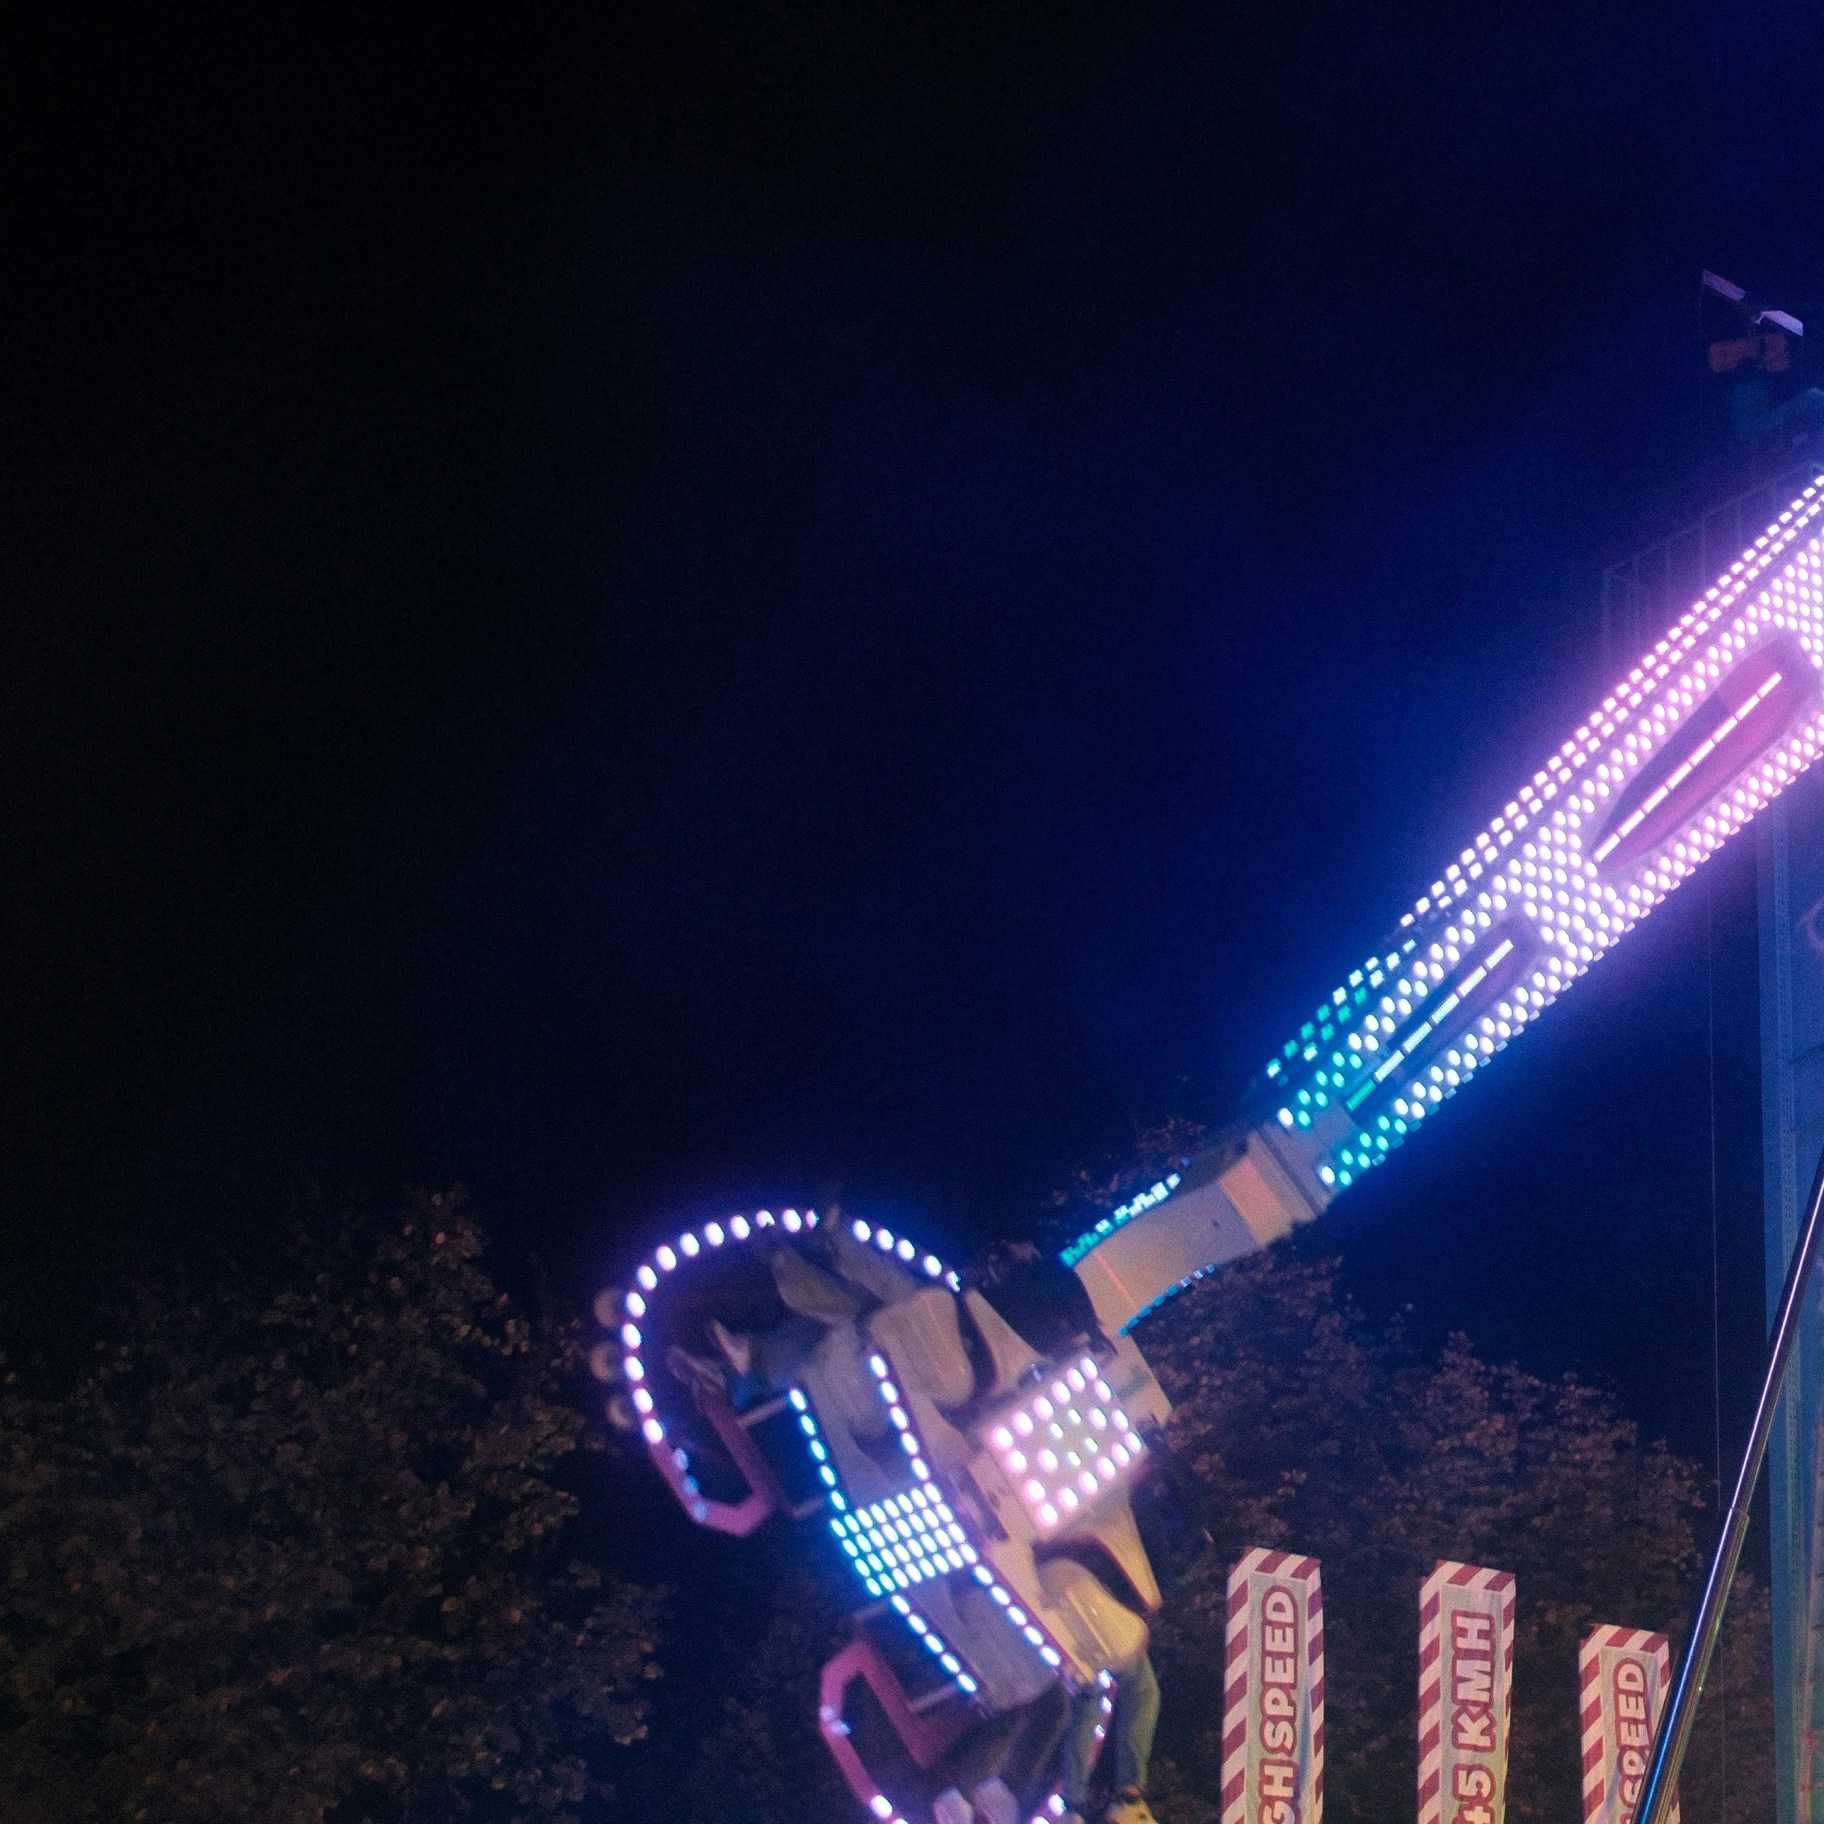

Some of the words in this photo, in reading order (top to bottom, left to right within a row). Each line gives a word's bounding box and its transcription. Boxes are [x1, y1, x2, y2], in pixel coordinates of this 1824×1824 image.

[1260, 1585, 1298, 1756] SPEED
[1450, 1609, 1497, 1750] KMH
[1612, 1658, 1654, 1808] SPEED
